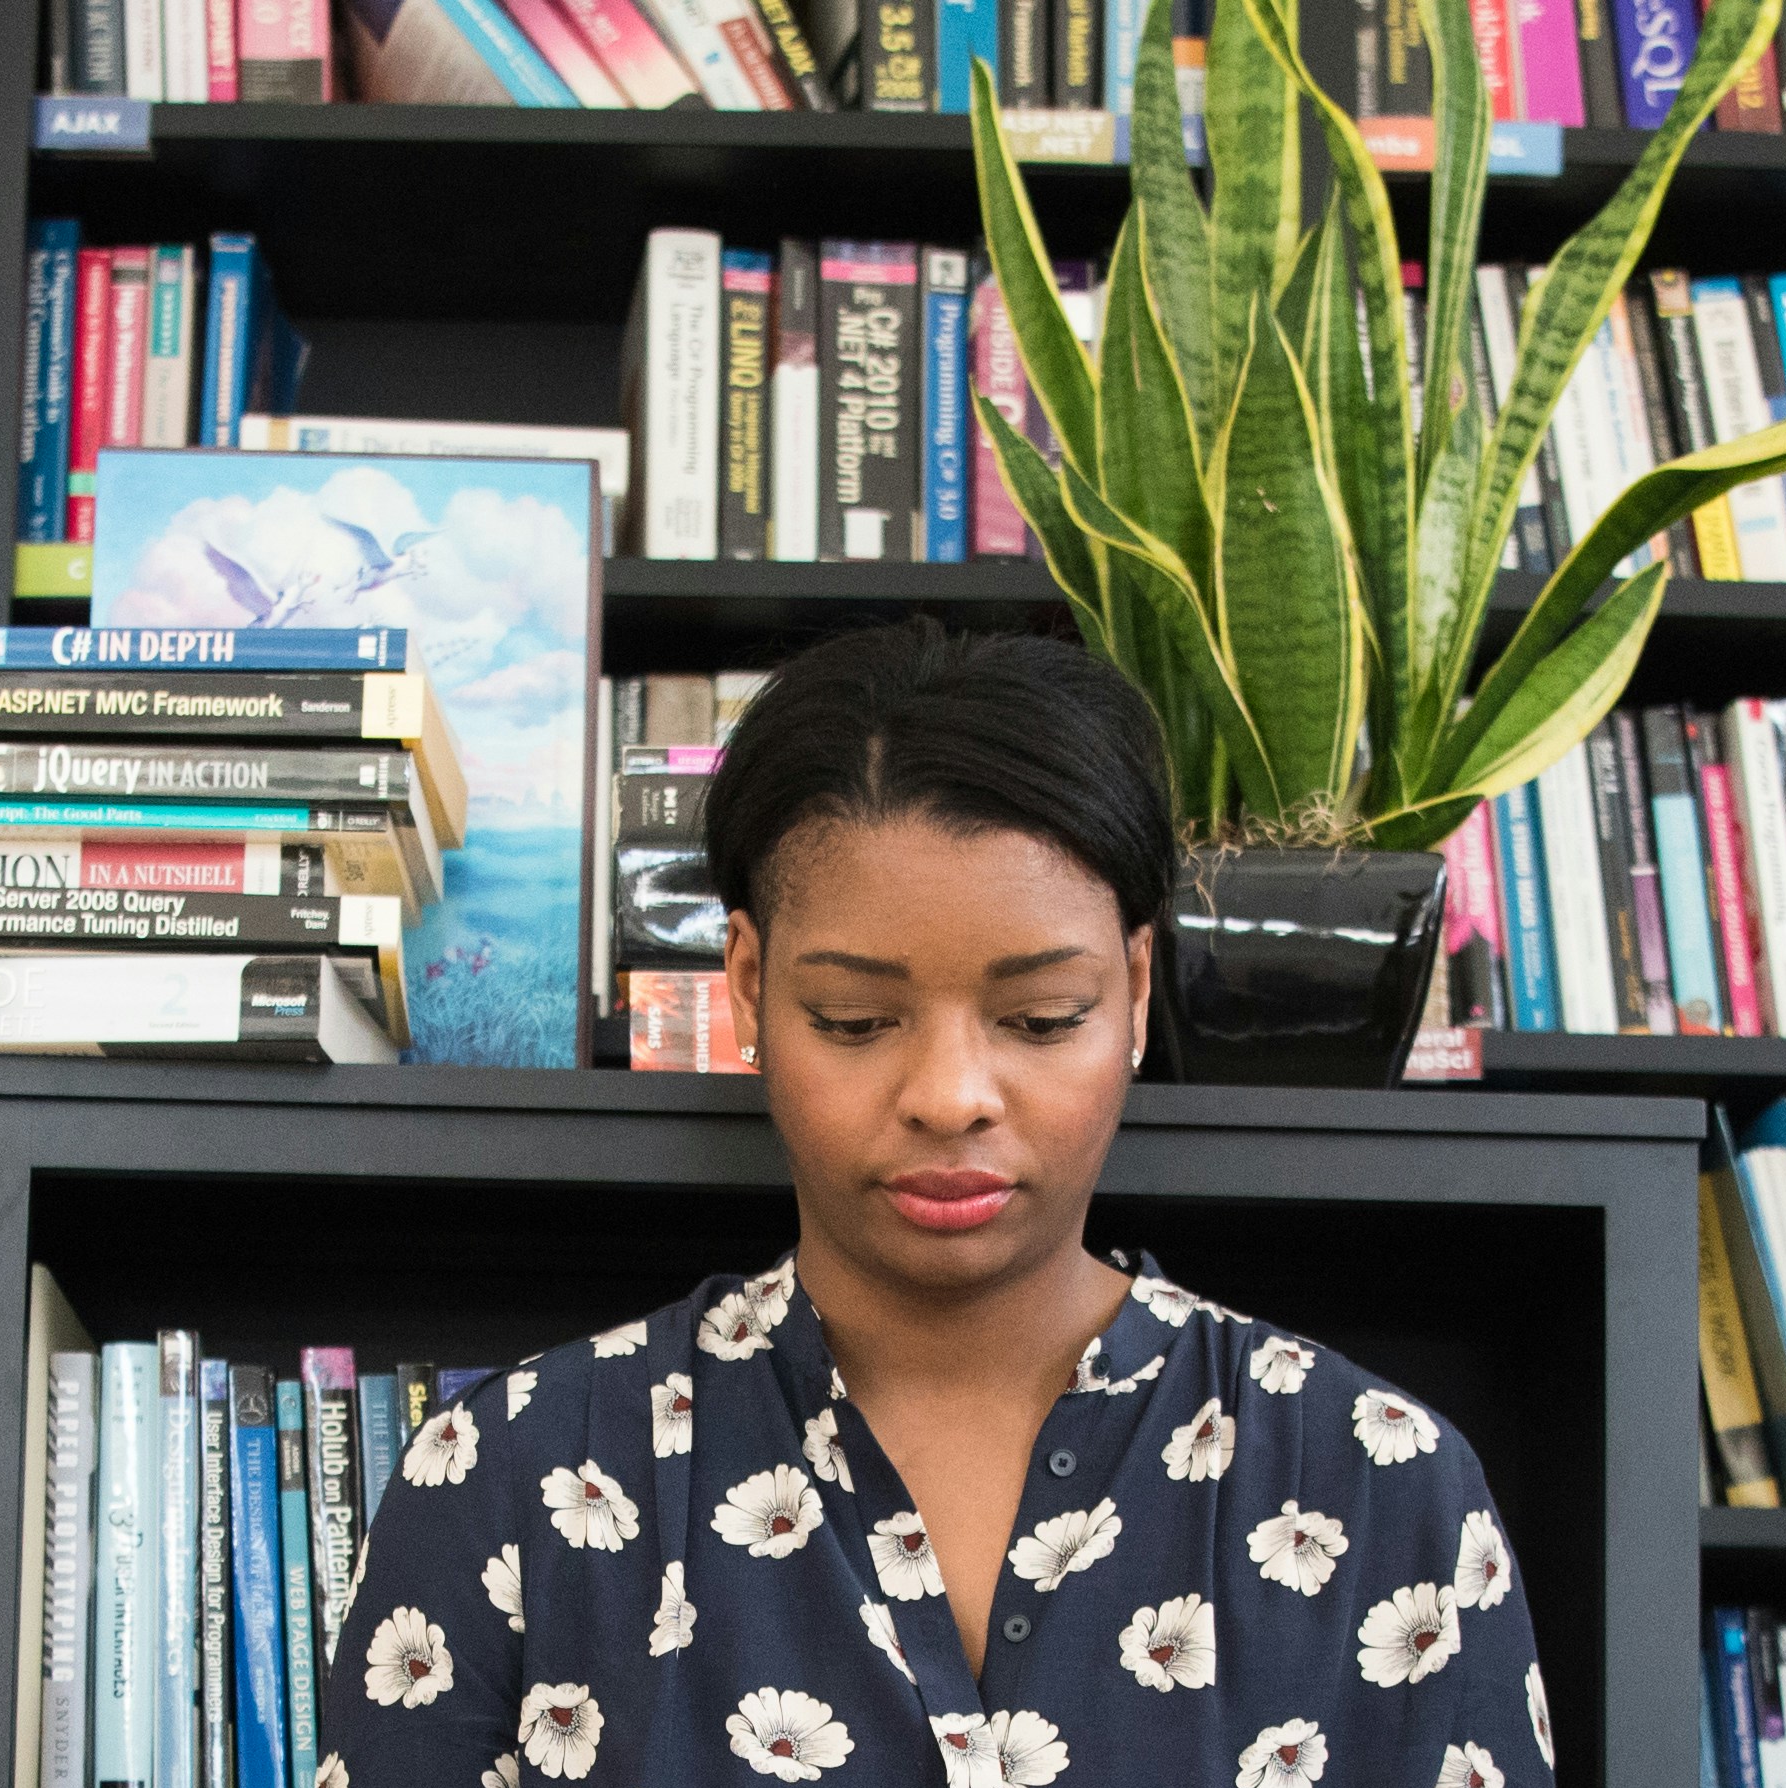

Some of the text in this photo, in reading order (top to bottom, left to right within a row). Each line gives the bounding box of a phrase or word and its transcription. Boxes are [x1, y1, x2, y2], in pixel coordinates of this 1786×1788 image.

[52, 110, 120, 135] AJAX
[1036, 135, 1094, 156] .NET
[112, 286, 138, 441] High Performance
[667, 302, 687, 379] Language
[728, 322, 763, 388] LINQ
[865, 308, 901, 430] C# 2010
[20, 308, 46, 464] Communications
[835, 307, 866, 504] .NET 4 Platform
[933, 302, 962, 521] Programming C# 3.0
[684, 366, 703, 475] Programming
[52, 626, 236, 666] C# IN DEPTH
[95, 690, 148, 716] MVC
[153, 690, 284, 718] Framework
[300, 700, 351, 714] Sanderson
[32, 746, 269, 795] jQuery IN ACTION
[34, 805, 143, 823] The Good Parts
[66, 887, 119, 912] 2008
[122, 890, 186, 918] Query
[88, 864, 110, 885] IN
[114, 865, 129, 885] A
[132, 864, 237, 887] NUTSHELL
[81, 912, 150, 939] Tuning
[155, 913, 240, 938] Distilled
[160, 972, 191, 1018] 2
[251, 992, 308, 1008] Microsoft
[274, 1005, 306, 1018] Press
[695, 981, 713, 1074] UNLEASHED
[246, 1438, 261, 1472] THE
[320, 1401, 352, 1617] Holub on Patterns
[52, 1378, 80, 1780] PAPER PROTOTYPING SNYDER
[205, 1410, 226, 1724] User Interface Design for Programmers
[287, 1566, 314, 1752] WEB PAGE DESIGN
